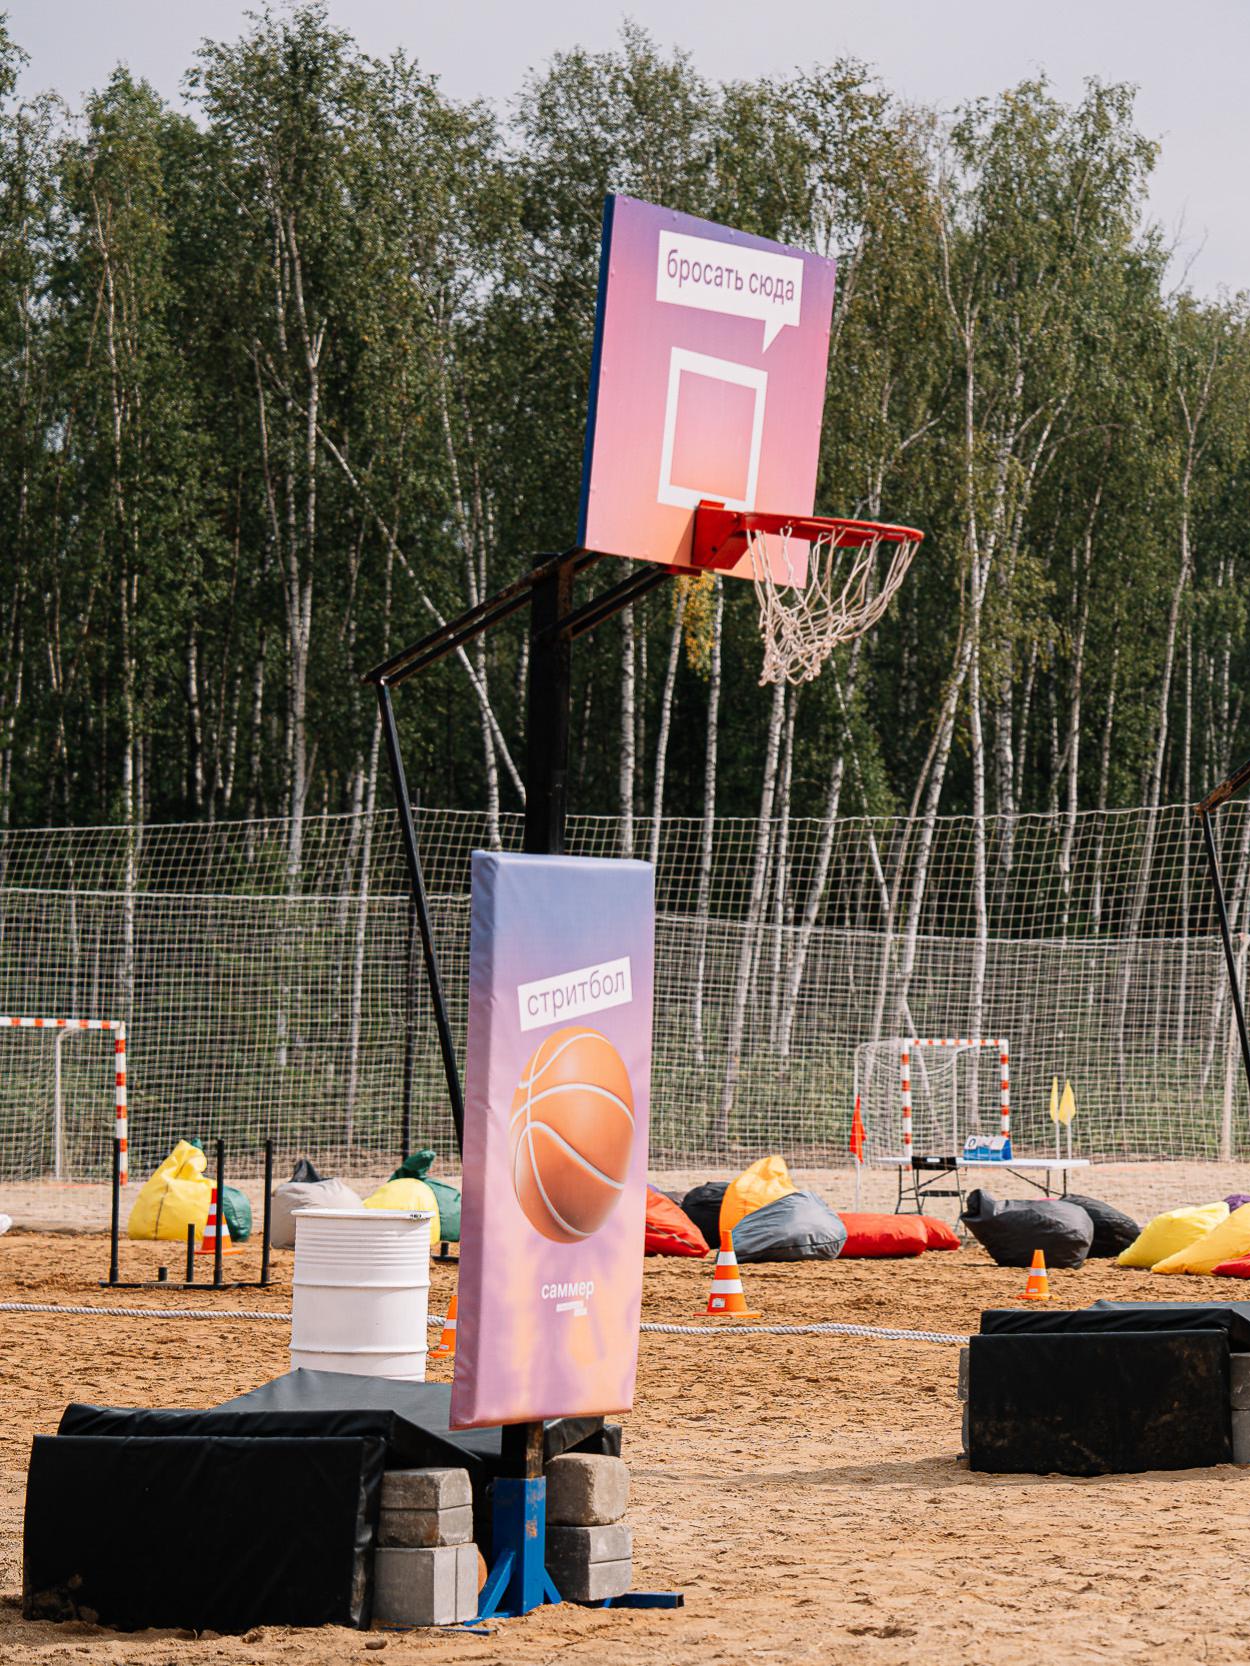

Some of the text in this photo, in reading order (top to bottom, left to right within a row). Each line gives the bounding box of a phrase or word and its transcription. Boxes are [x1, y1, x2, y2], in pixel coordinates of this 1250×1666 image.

[667, 249, 795, 305] бросать сюда
[527, 970, 625, 1018] стритбол
[541, 1281, 594, 1300] саммер
